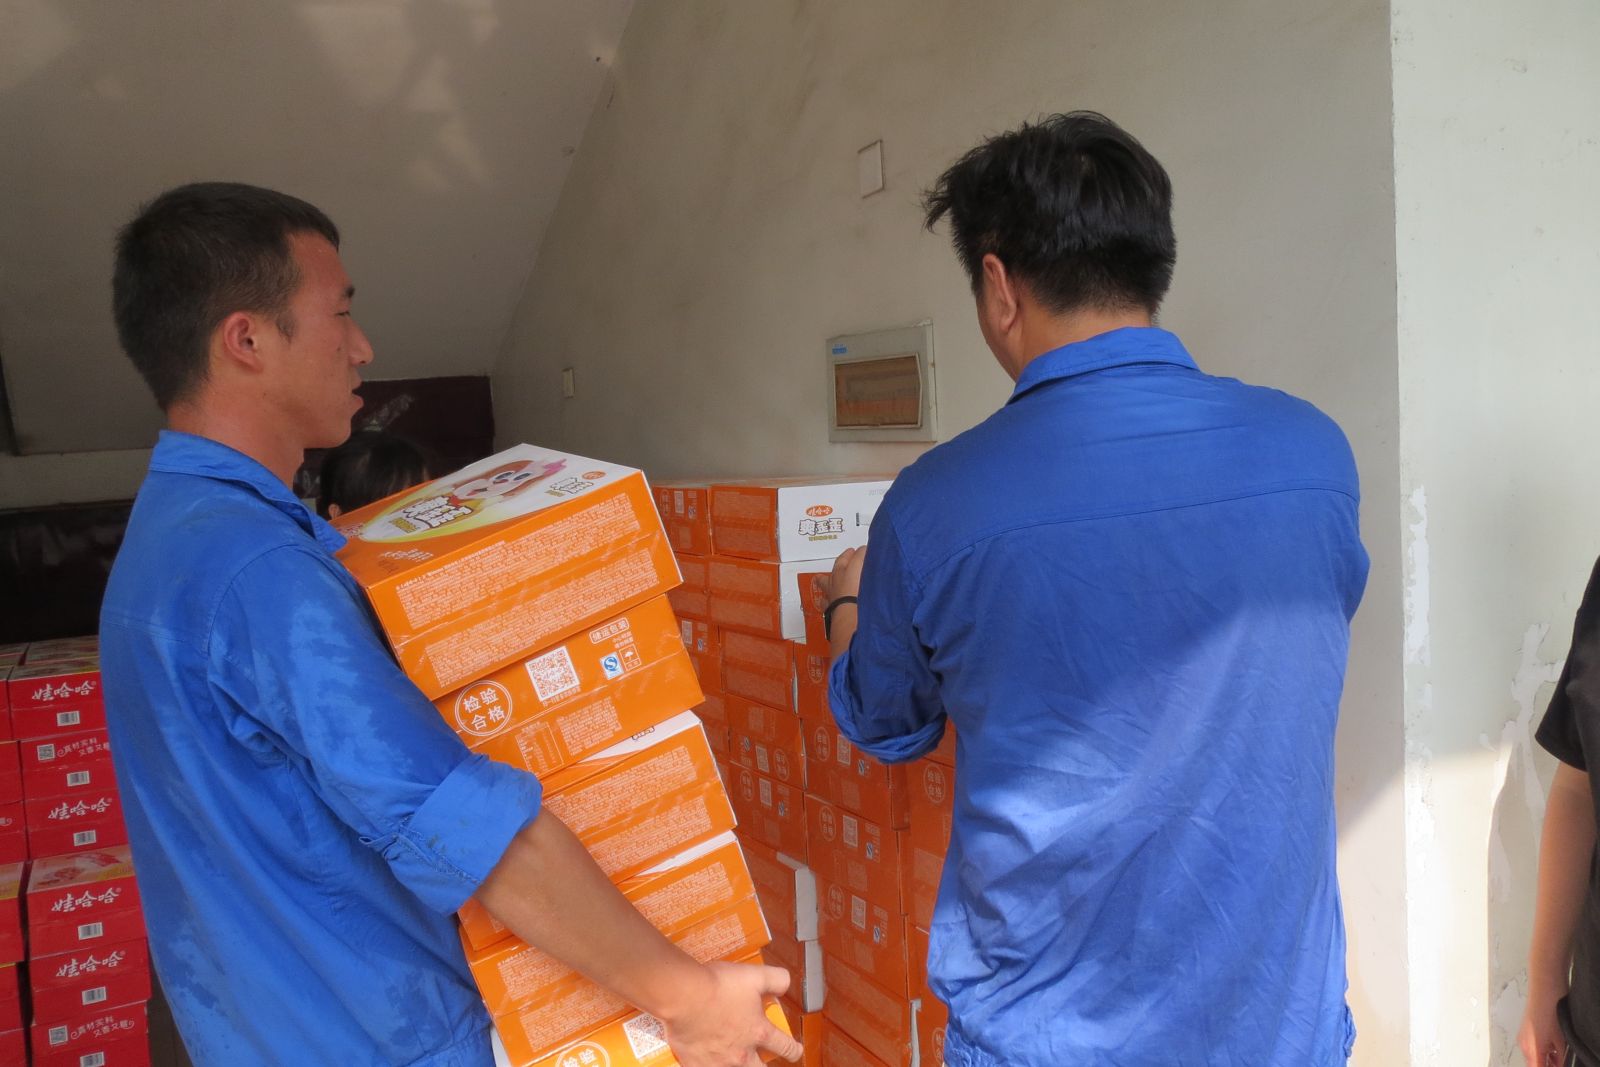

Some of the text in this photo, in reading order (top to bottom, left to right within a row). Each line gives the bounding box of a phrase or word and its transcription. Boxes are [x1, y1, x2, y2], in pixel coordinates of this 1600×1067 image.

[32, 680, 95, 701] 娃哈哈
[462, 687, 499, 714] 检验
[471, 705, 505, 731] 合格
[48, 797, 111, 820] 娃哈哈
[51, 887, 120, 912] 娃哈哈
[56, 951, 124, 977] 娃哈哈
